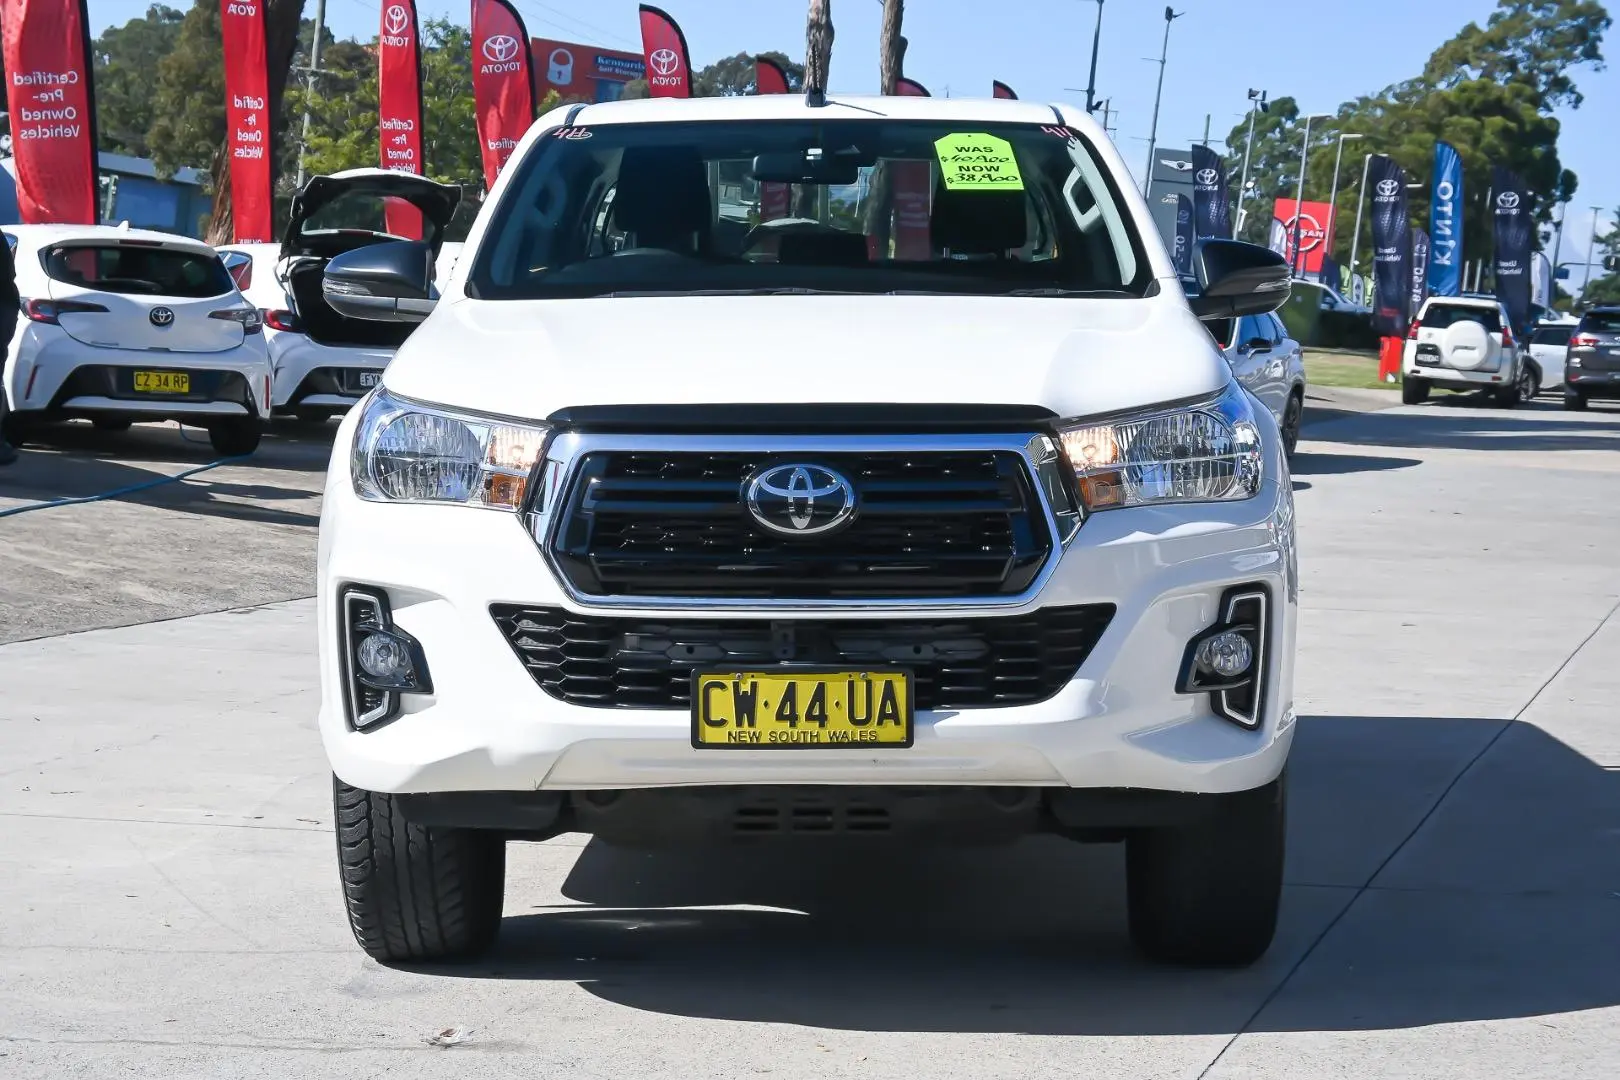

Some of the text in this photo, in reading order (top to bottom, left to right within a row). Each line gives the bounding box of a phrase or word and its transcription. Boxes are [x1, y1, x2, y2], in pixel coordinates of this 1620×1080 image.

[597, 56, 645, 70] Kennards
[954, 145, 994, 153] WAS
[135, 373, 188, 389] CZ 34 RP
[727, 729, 877, 742] NEW SOUTH WALES
